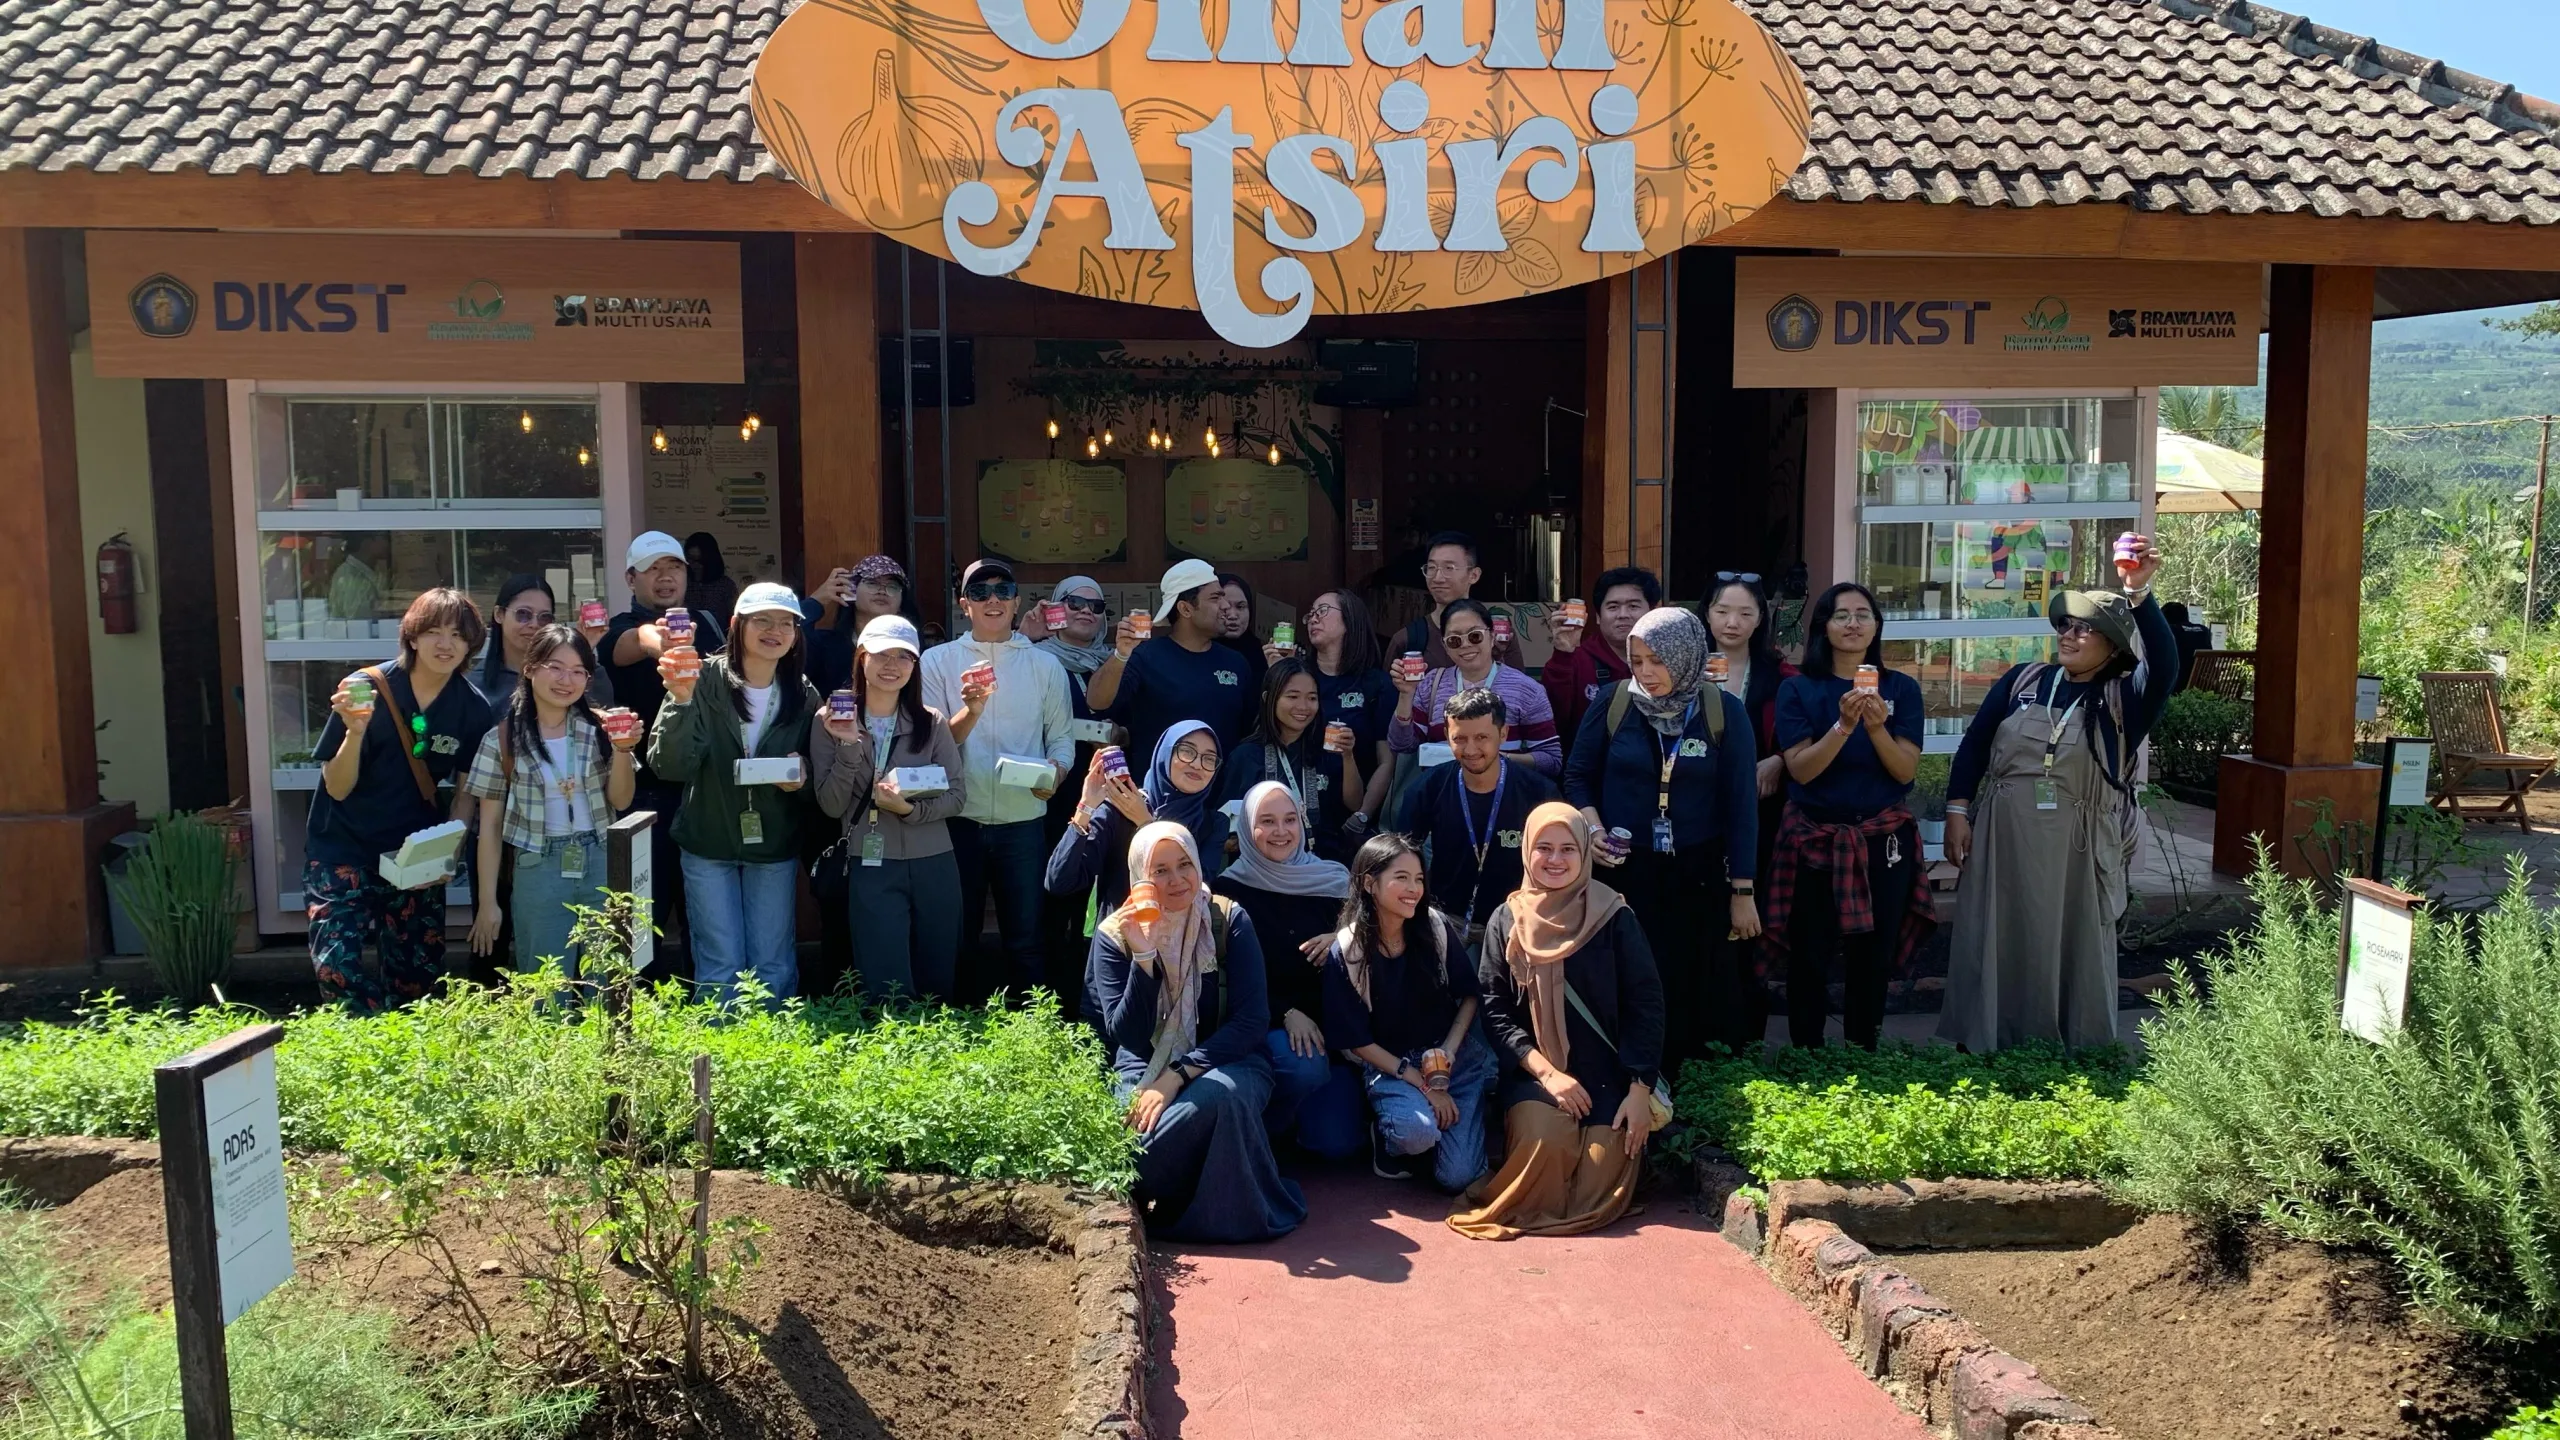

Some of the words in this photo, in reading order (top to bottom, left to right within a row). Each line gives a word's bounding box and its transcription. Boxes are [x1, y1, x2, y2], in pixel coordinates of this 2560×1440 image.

[943, 79, 1645, 347] Atsiri
[214, 282, 406, 333] DIKST
[594, 297, 712, 314] BRAWIJAYA
[594, 315, 648, 328] MULTI
[653, 316, 712, 328] USAHA
[1835, 301, 1991, 344] DIKST
[2141, 310, 2236, 325] BRAWIJAYA
[2141, 327, 2184, 338] MULTI
[2187, 327, 2236, 338] USAHA
[2366, 941, 2403, 964] ROSEMARY
[223, 1124, 255, 1165] ADAS
